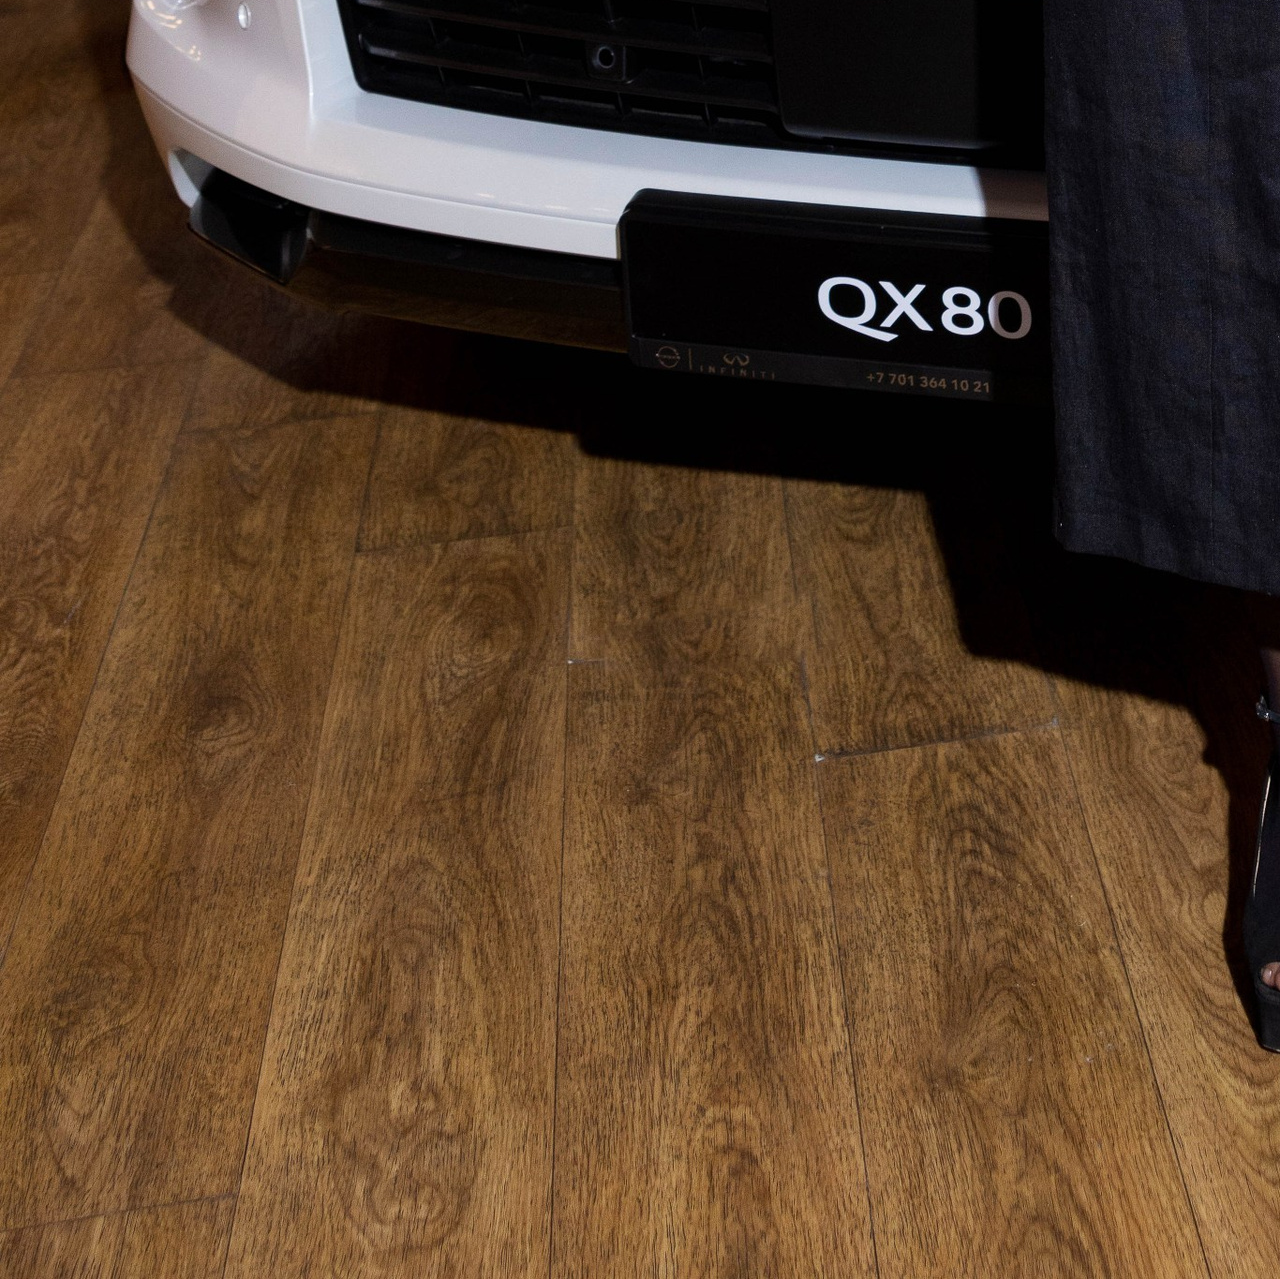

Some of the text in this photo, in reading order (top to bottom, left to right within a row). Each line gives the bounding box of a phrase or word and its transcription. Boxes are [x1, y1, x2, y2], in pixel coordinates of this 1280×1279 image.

[817, 276, 1032, 342] QX80
[700, 365, 776, 381] INFINITI
[866, 372, 990, 394] +7 701 364 10 21
